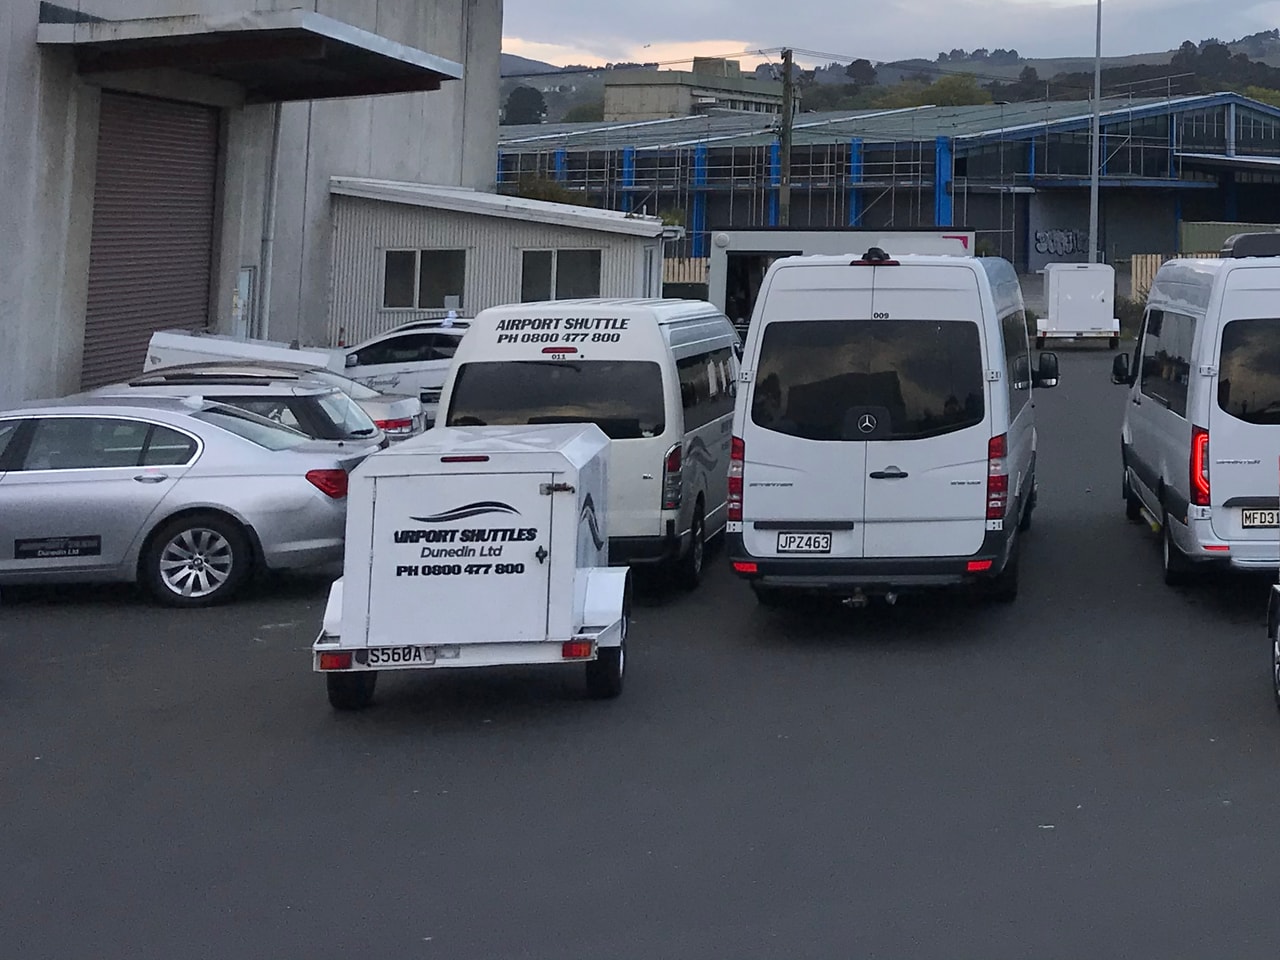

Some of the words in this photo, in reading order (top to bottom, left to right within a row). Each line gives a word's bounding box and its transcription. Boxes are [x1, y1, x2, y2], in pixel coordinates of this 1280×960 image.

[496, 318, 562, 331] AIRPORT
[564, 318, 630, 330] SHUTTLE
[497, 333, 518, 343] PH
[521, 333, 559, 343] 0800
[562, 333, 589, 342] 477
[591, 333, 620, 342] 800
[1244, 512, 1280, 524] MFD31
[459, 528, 537, 542] SHUTTLES
[780, 535, 829, 549] JPZ463
[420, 546, 476, 558] Dunedin
[479, 545, 503, 557] Ltd
[396, 565, 419, 576] PH
[421, 564, 462, 576] 0800
[464, 564, 492, 575] 477
[494, 563, 525, 574] 800
[370, 647, 422, 663] S560A
